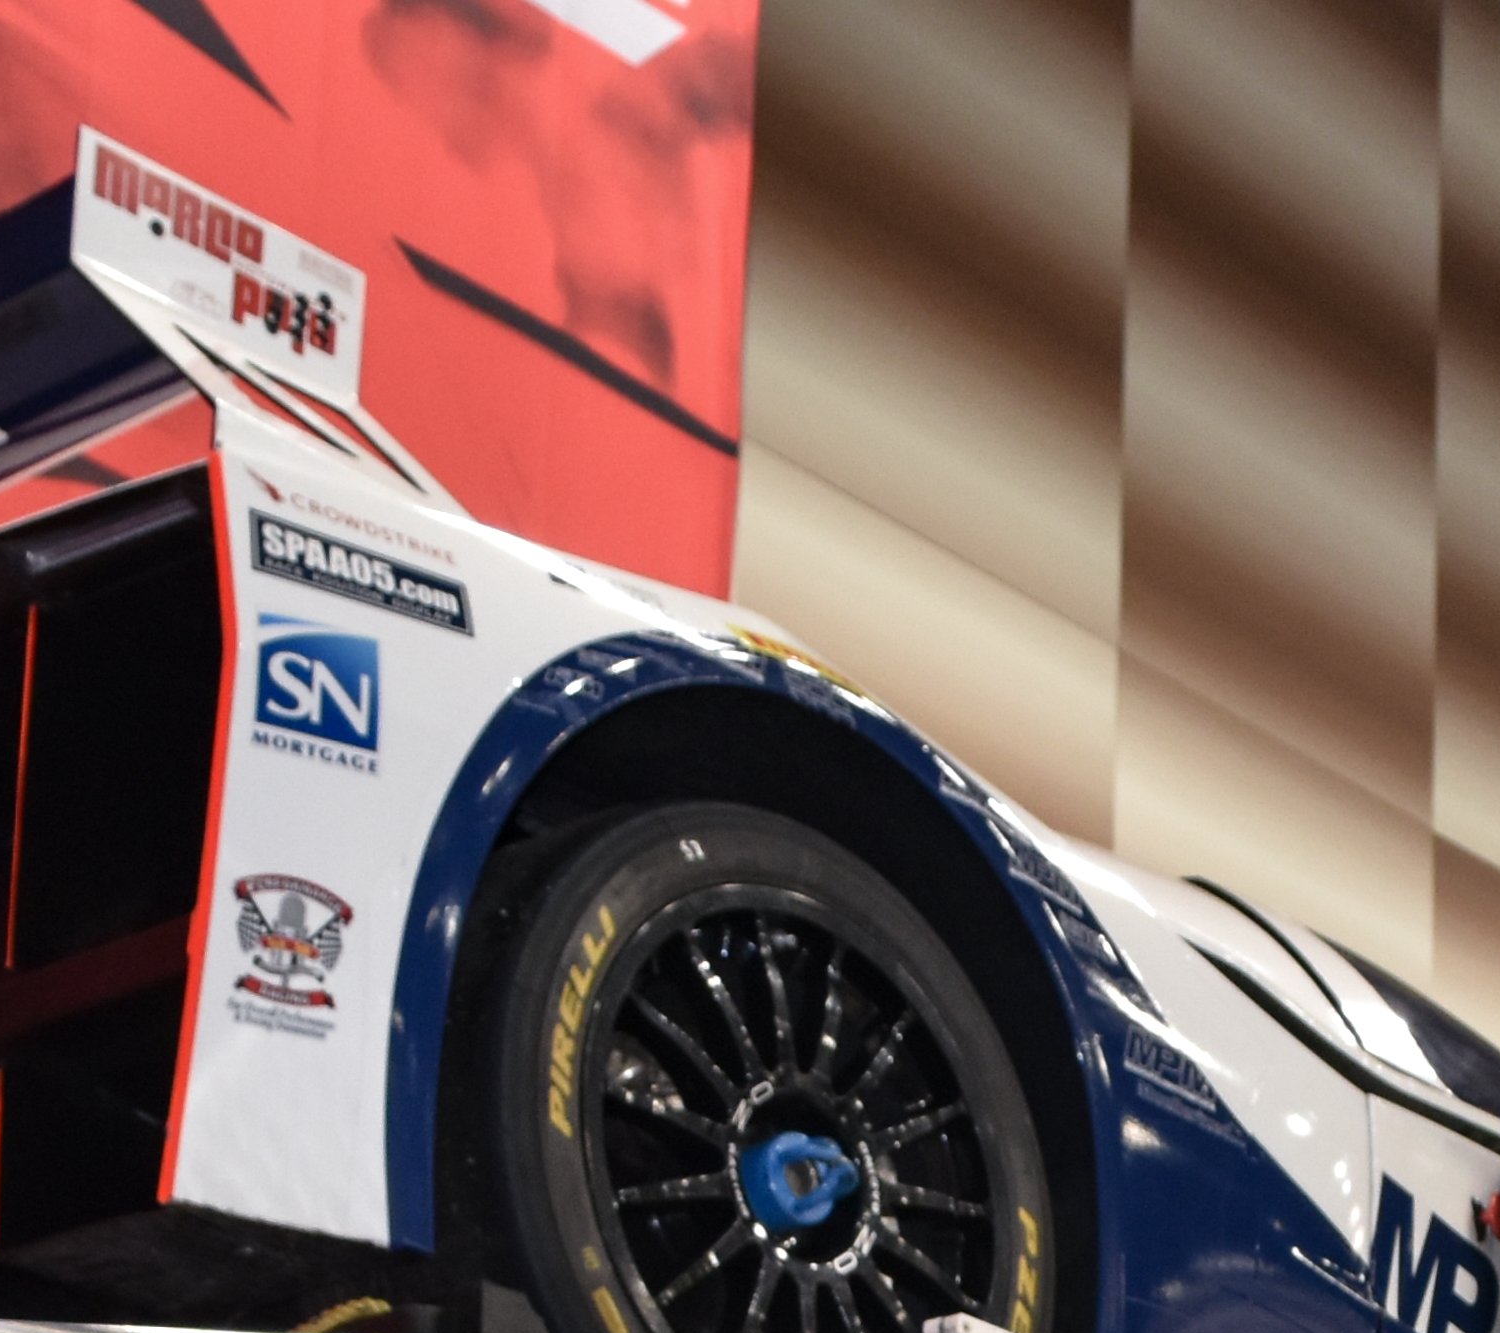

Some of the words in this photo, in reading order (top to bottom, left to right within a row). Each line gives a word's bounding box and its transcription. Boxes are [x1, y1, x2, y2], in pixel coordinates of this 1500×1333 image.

[261, 521, 460, 617] SPAA05.com
[266, 651, 371, 737] SN
[251, 730, 378, 774] MORTGAGE
[548, 905, 616, 1139] PIRELLI
